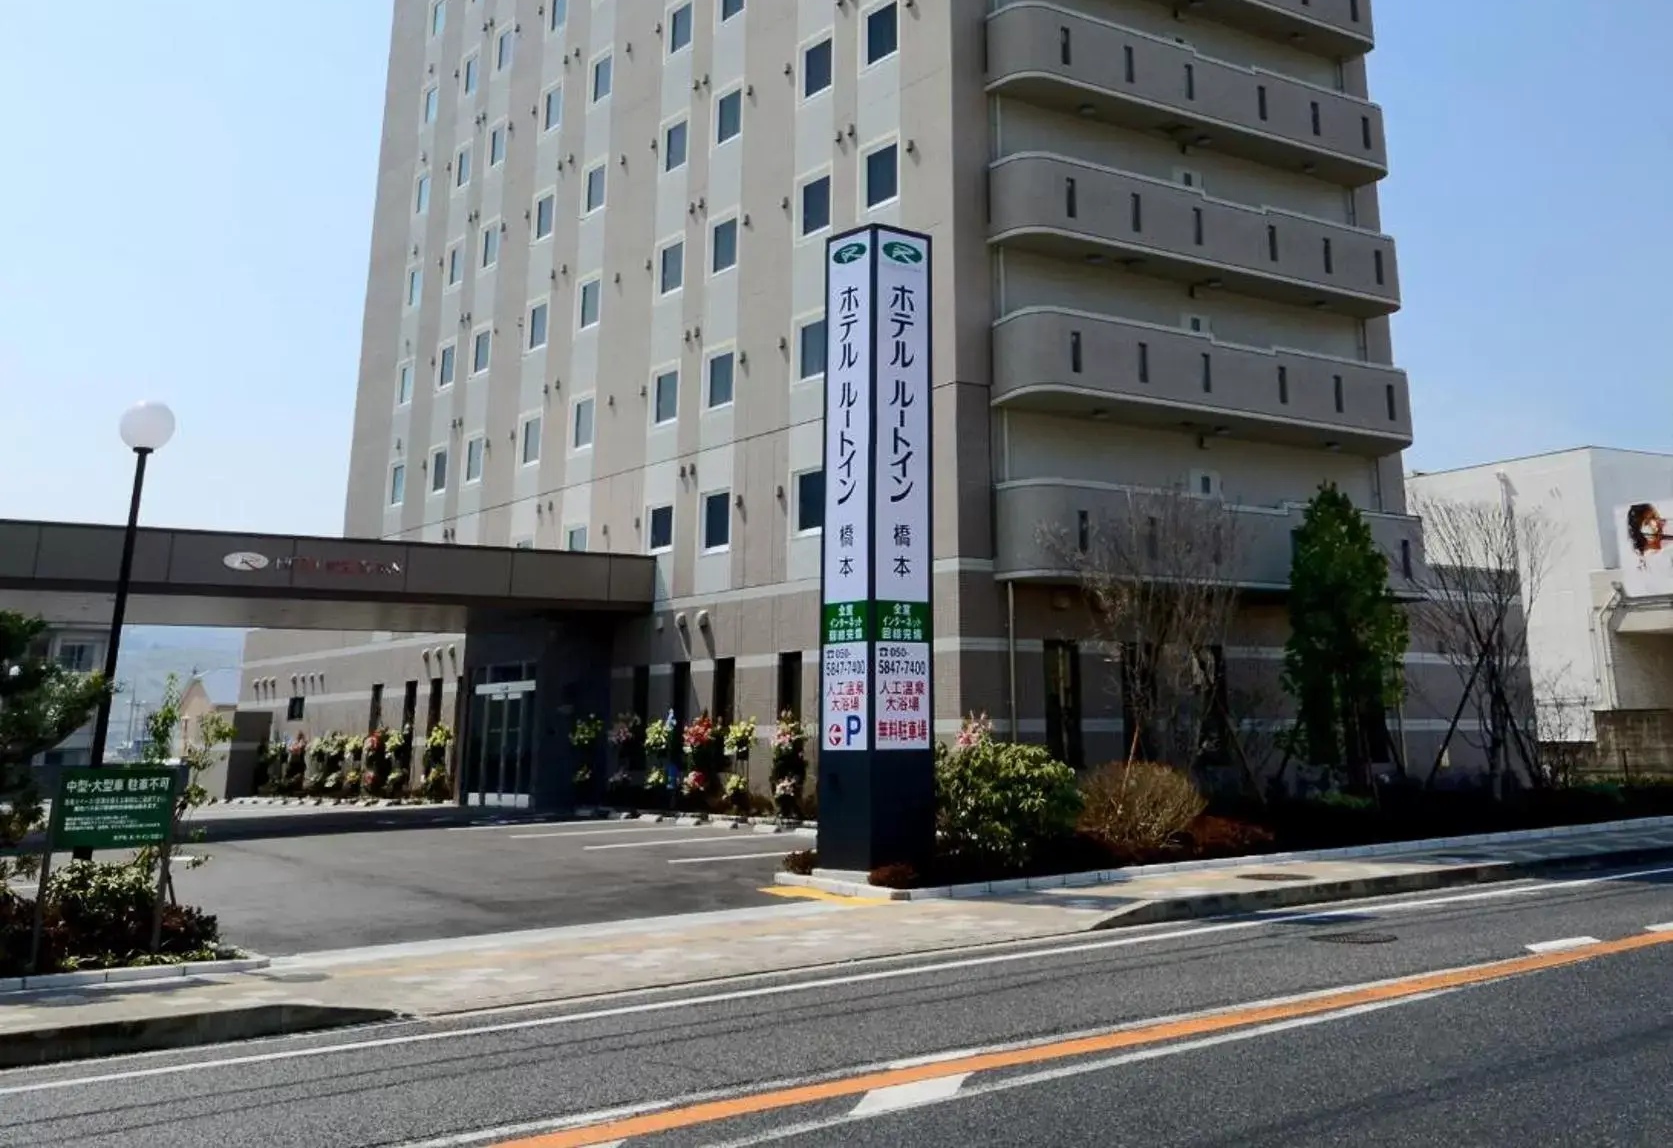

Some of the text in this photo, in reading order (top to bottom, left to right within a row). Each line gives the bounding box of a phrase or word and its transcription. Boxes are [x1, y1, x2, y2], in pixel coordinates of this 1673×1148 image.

[890, 285, 915, 369] ホテル
[838, 286, 859, 577] ホテル ルートイン 橋本
[890, 380, 915, 503] ルートイン
[893, 524, 911, 577] 橋本
[878, 660, 926, 675] 5847-7400
[879, 680, 925, 695] 人工温泉
[885, 696, 920, 711] 大浴場
[846, 714, 861, 746] P
[878, 720, 928, 741] 無料駐車場
